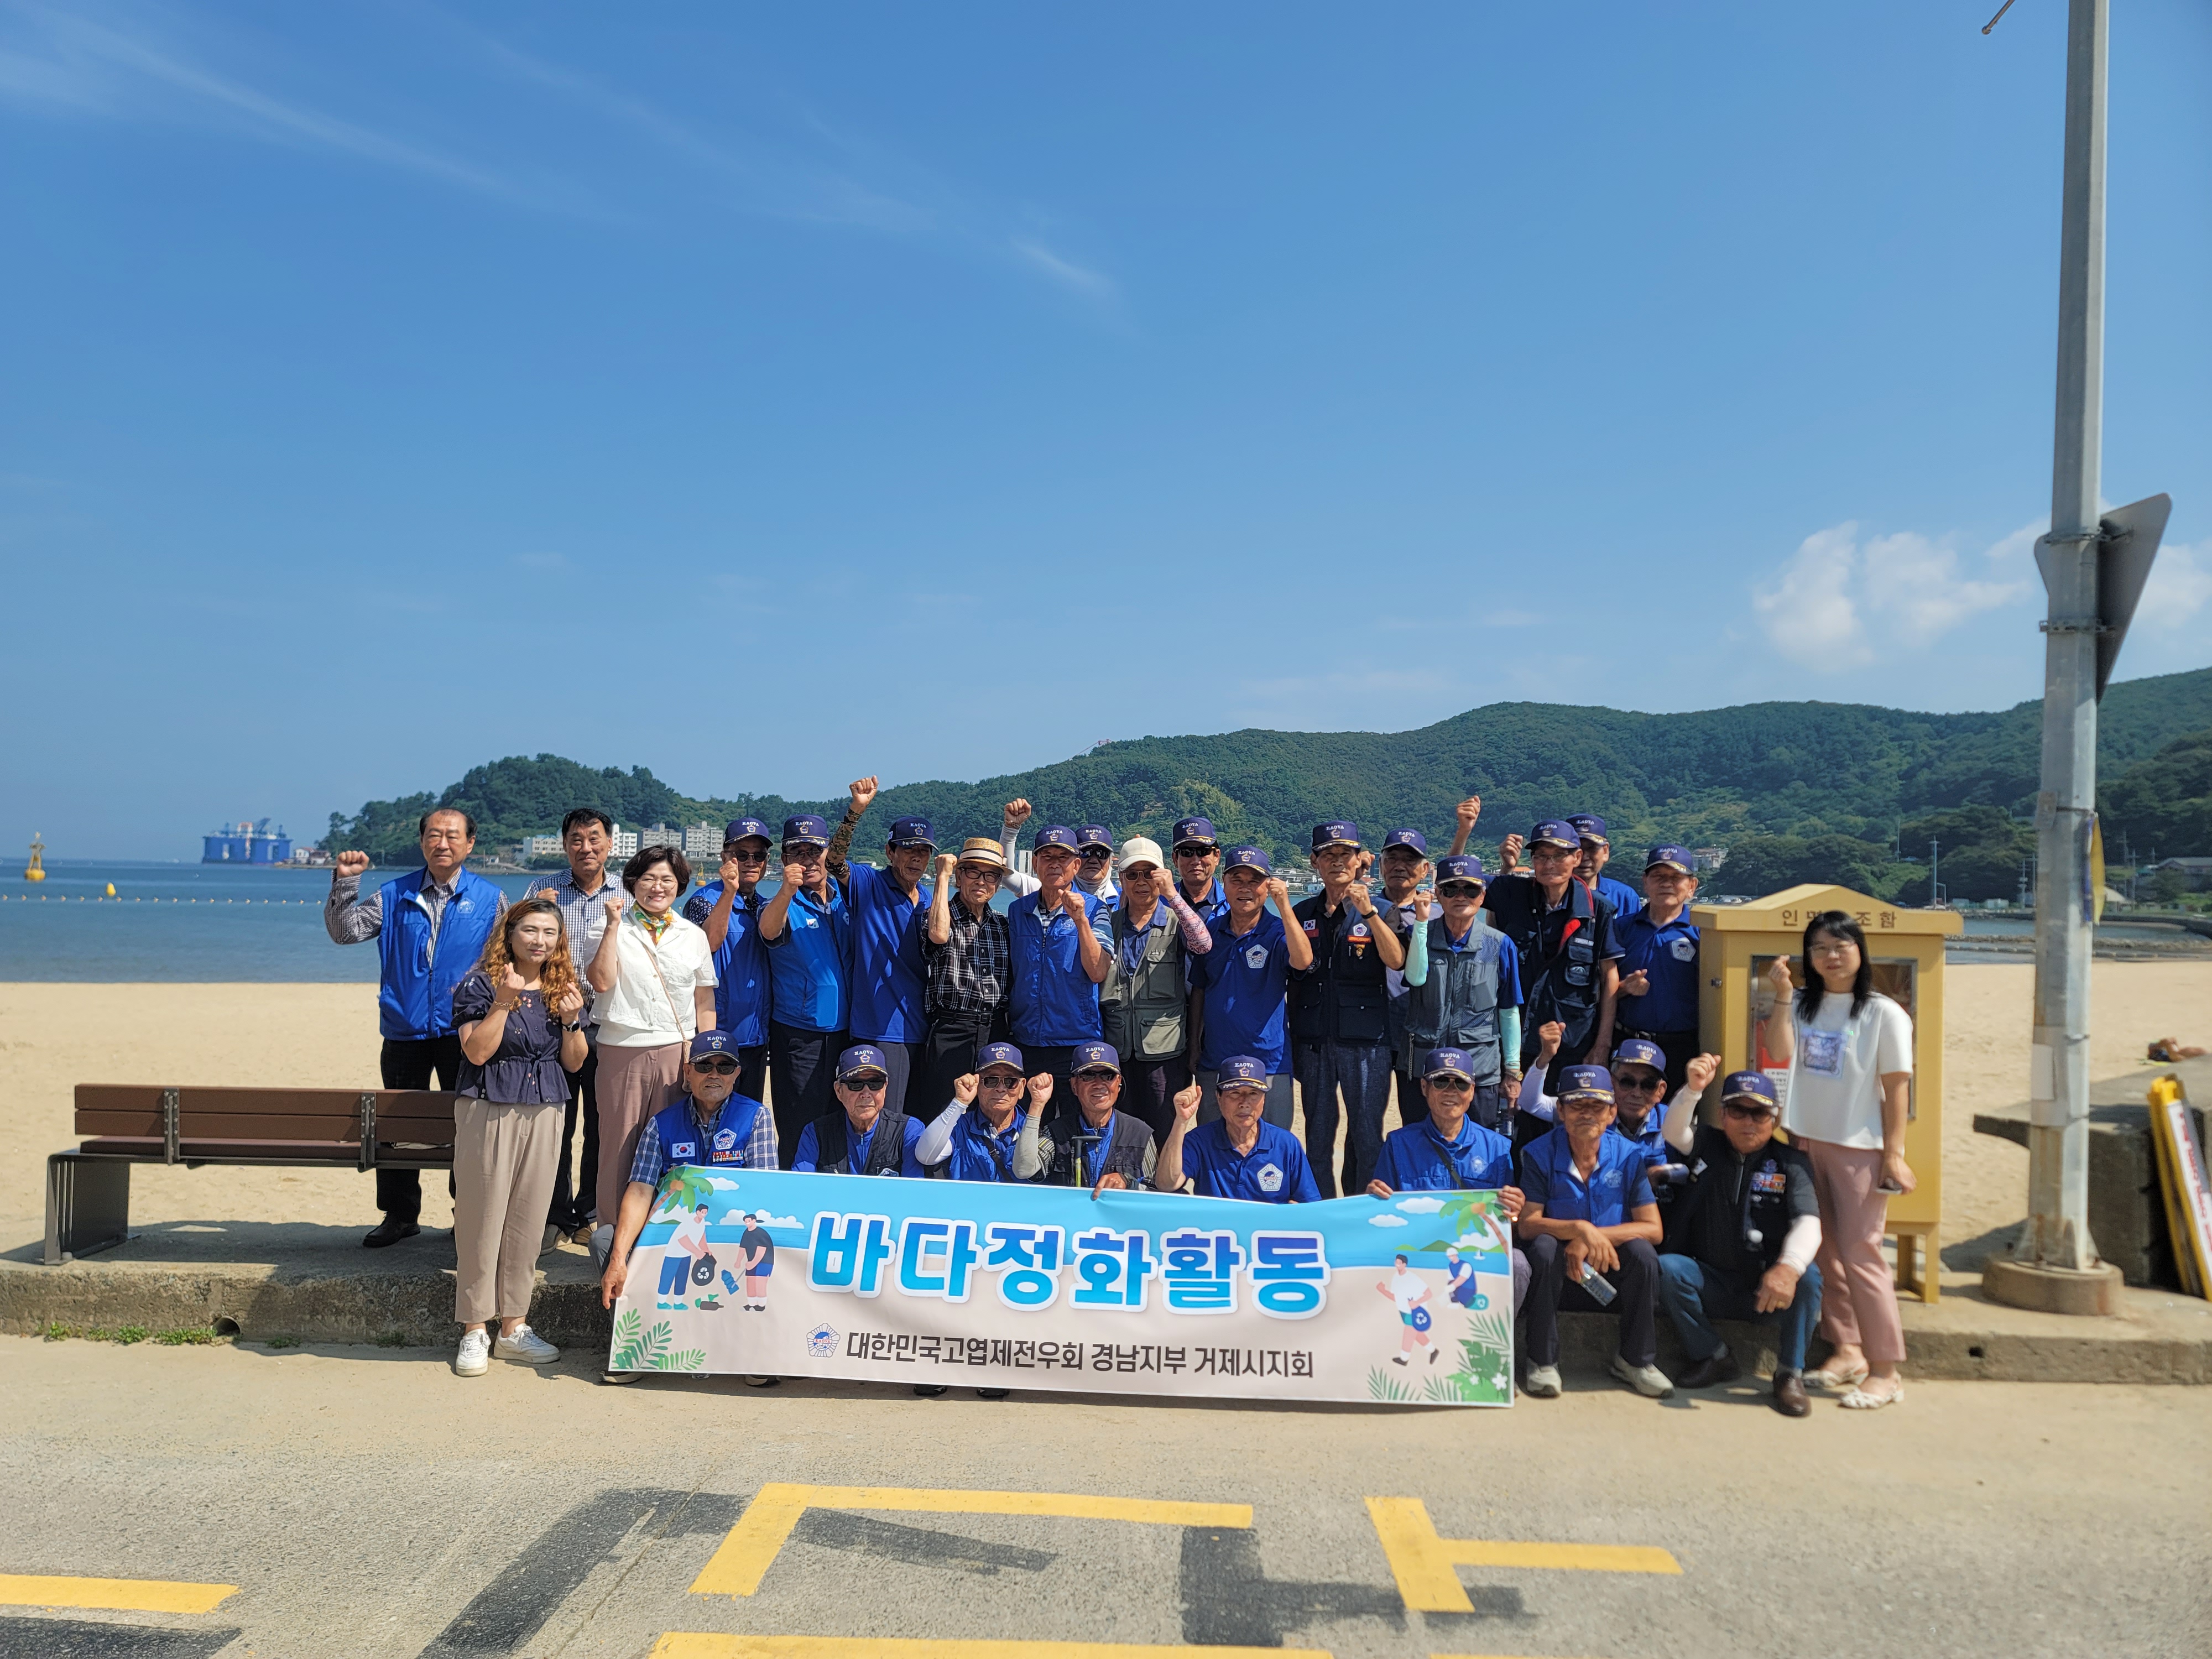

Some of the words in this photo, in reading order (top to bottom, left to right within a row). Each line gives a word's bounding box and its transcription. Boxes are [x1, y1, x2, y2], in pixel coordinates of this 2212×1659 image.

[808, 1213, 1329, 1317] 바다정화활동
[846, 1332, 1083, 1370] 대한민국고엽제전우회
[1091, 1344, 1187, 1374] 경남지부
[1194, 1348, 1314, 1378] 거제시지회
